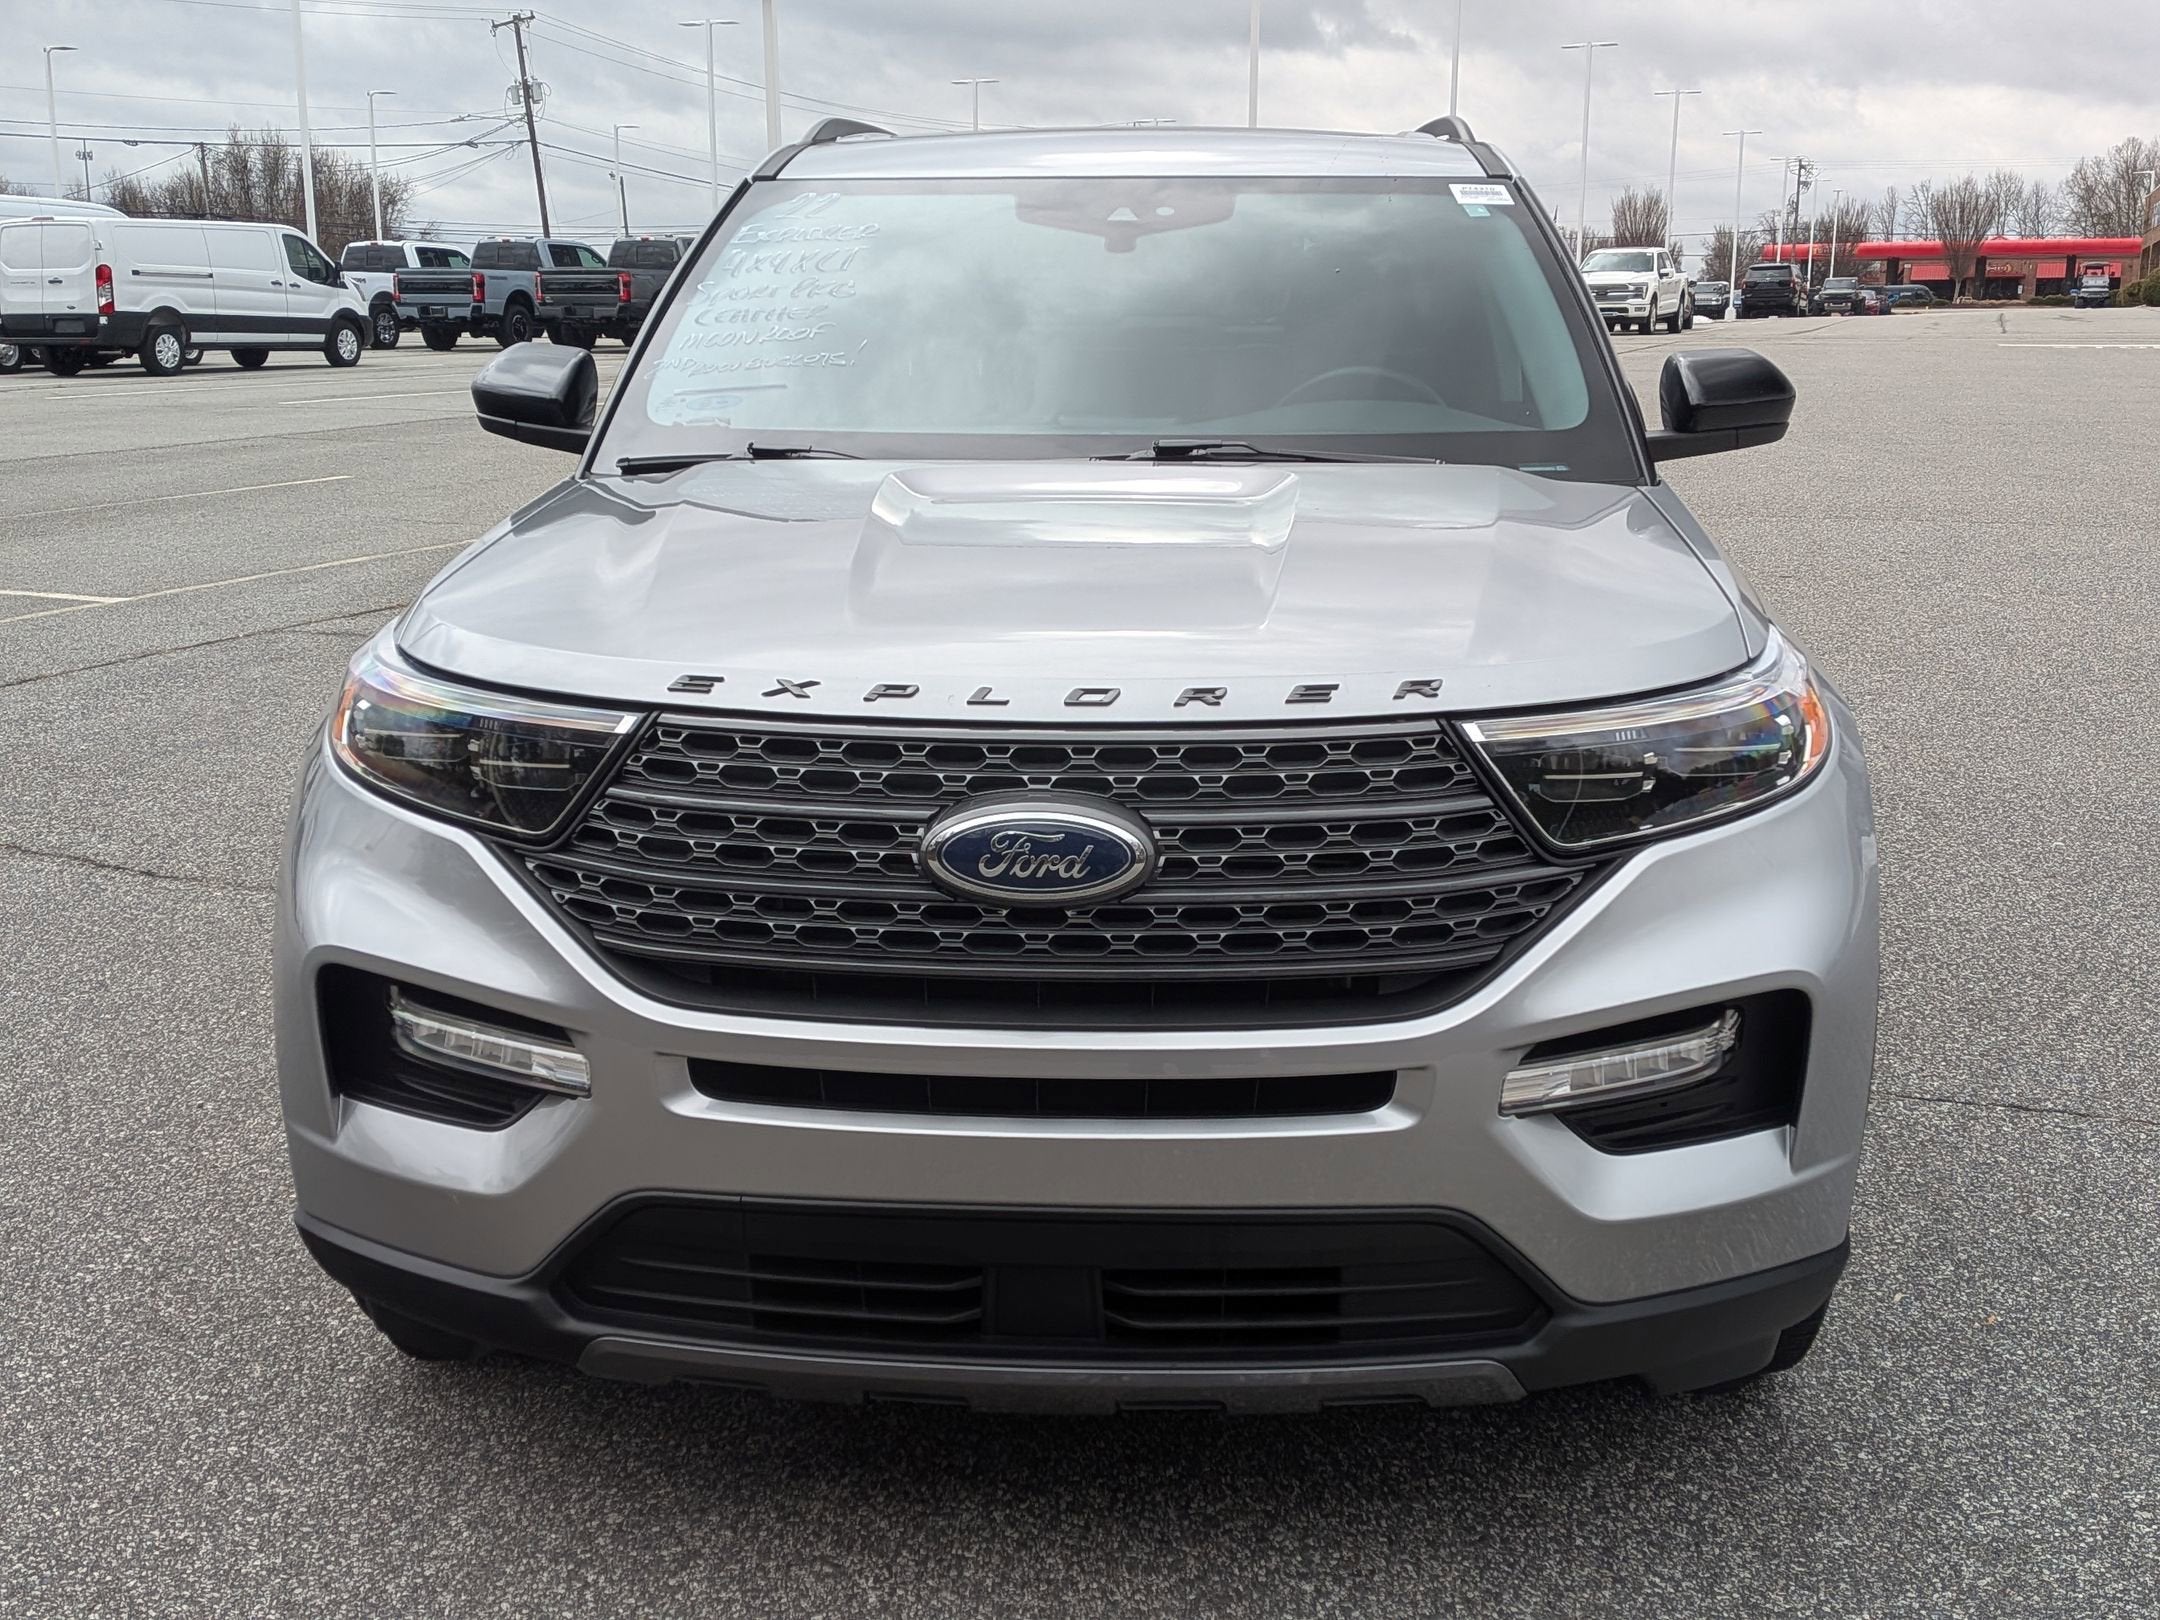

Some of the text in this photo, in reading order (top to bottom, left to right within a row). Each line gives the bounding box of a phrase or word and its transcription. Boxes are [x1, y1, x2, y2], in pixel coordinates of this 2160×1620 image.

[775, 192, 841, 219] 22
[666, 674, 1445, 707] EXPLORER
[978, 830, 1095, 879] Ford
